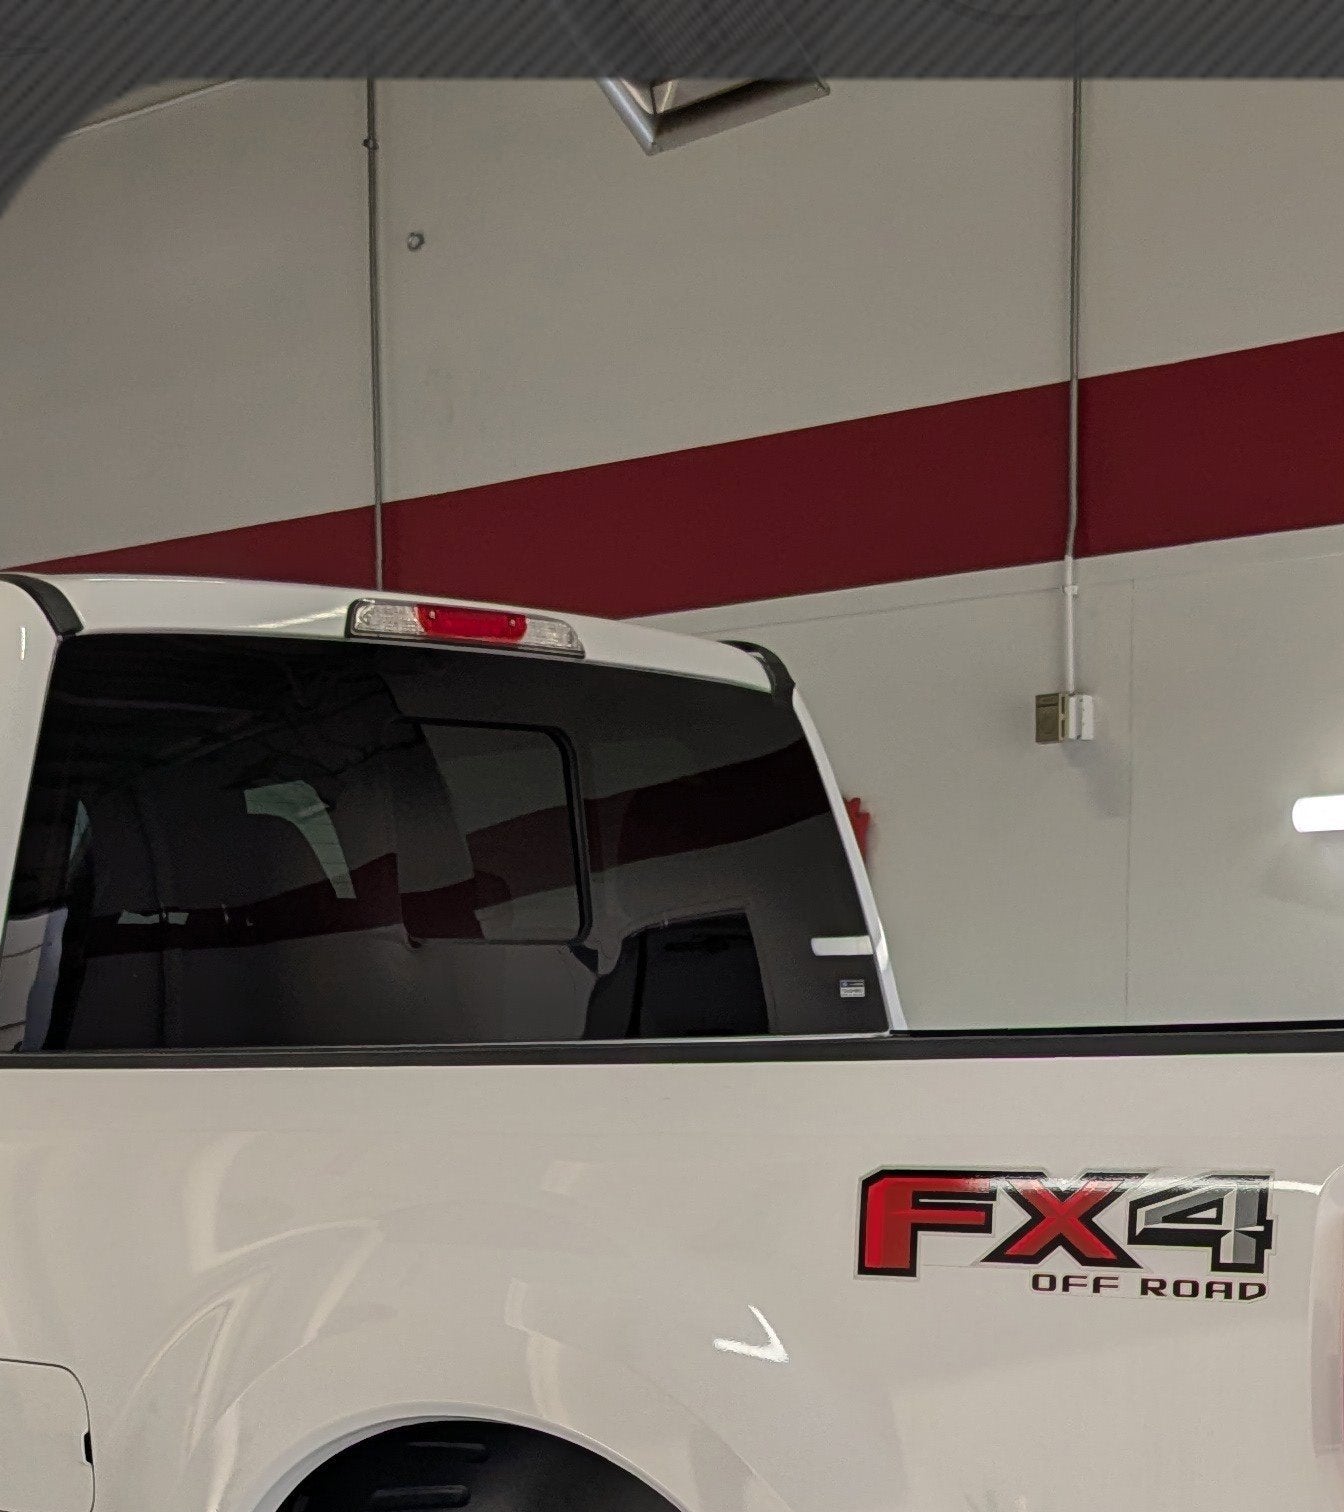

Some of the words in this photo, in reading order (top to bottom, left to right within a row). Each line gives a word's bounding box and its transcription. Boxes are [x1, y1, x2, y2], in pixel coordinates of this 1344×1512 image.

[857, 1168, 1274, 1278] FX4
[1030, 1273, 1120, 1295] OFF
[1140, 1277, 1268, 1301] ROAD
